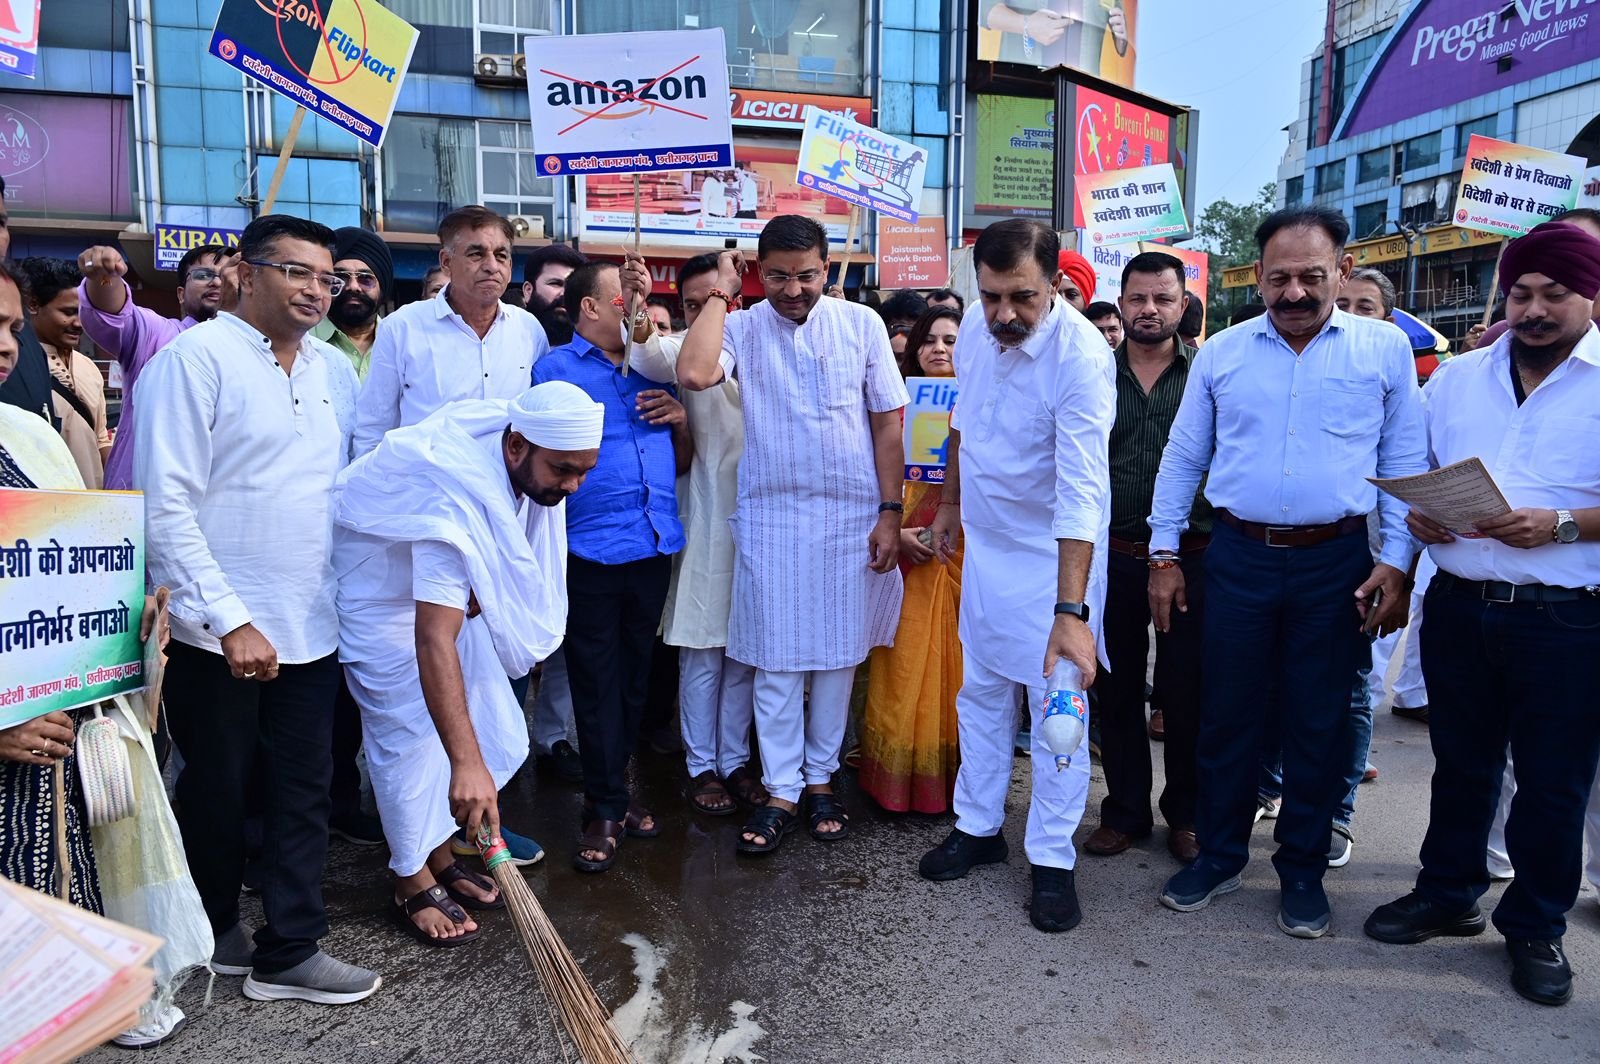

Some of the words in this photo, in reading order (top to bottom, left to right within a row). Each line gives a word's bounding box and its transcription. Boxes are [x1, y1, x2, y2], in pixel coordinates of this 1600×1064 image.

[1410, 11, 1497, 66] Prega
[1480, 38, 1516, 62] Means
[1520, 25, 1549, 50] Good
[1551, 14, 1588, 37] News
[328, 26, 396, 83] Flipkart
[243, 55, 271, 80] स्वदेशी
[271, 70, 301, 97] जागरण
[321, 100, 355, 128] छत्तीसगढ़
[354, 119, 372, 137] प्रान्त
[546, 74, 707, 106] amazon
[741, 100, 797, 119] ICICI
[815, 114, 902, 159] Flipkart
[1023, 128, 1054, 139] मुख्यमं
[568, 155, 598, 170] स्वदेशी
[598, 156, 632, 169] जागरण
[655, 151, 696, 165] छत्तीसगढ़
[696, 150, 719, 163] प्रान्त
[1470, 156, 1502, 176] स्वदेशी
[1503, 162, 1514, 178] से
[1515, 164, 1532, 183] प्रेम
[1533, 168, 1573, 191] दिखाओ
[1091, 187, 1120, 201] भारत
[1122, 182, 1139, 197] की
[1142, 181, 1167, 195] शान
[1462, 184, 1493, 204] विदेशी
[1495, 191, 1509, 208] को
[1510, 197, 1526, 211] घर
[1526, 197, 1536, 213] से
[1093, 206, 1132, 223] स्वदेशी
[1134, 203, 1171, 218] सामान
[882, 255, 911, 263] Chowk
[913, 254, 942, 262] Branch
[891, 245, 932, 254] Jaistambh
[1093, 246, 1121, 267] विदेशी
[908, 273, 929, 281] Floor
[38, 537, 63, 576] को
[68, 537, 135, 575] अपनाओ
[0, 605, 74, 654] त्मनिर्भर
[78, 599, 130, 640] बनाओ
[27, 677, 61, 700] जागरण
[87, 666, 123, 685] छत्तीसगढ़
[124, 659, 141, 679] प्रान्त
